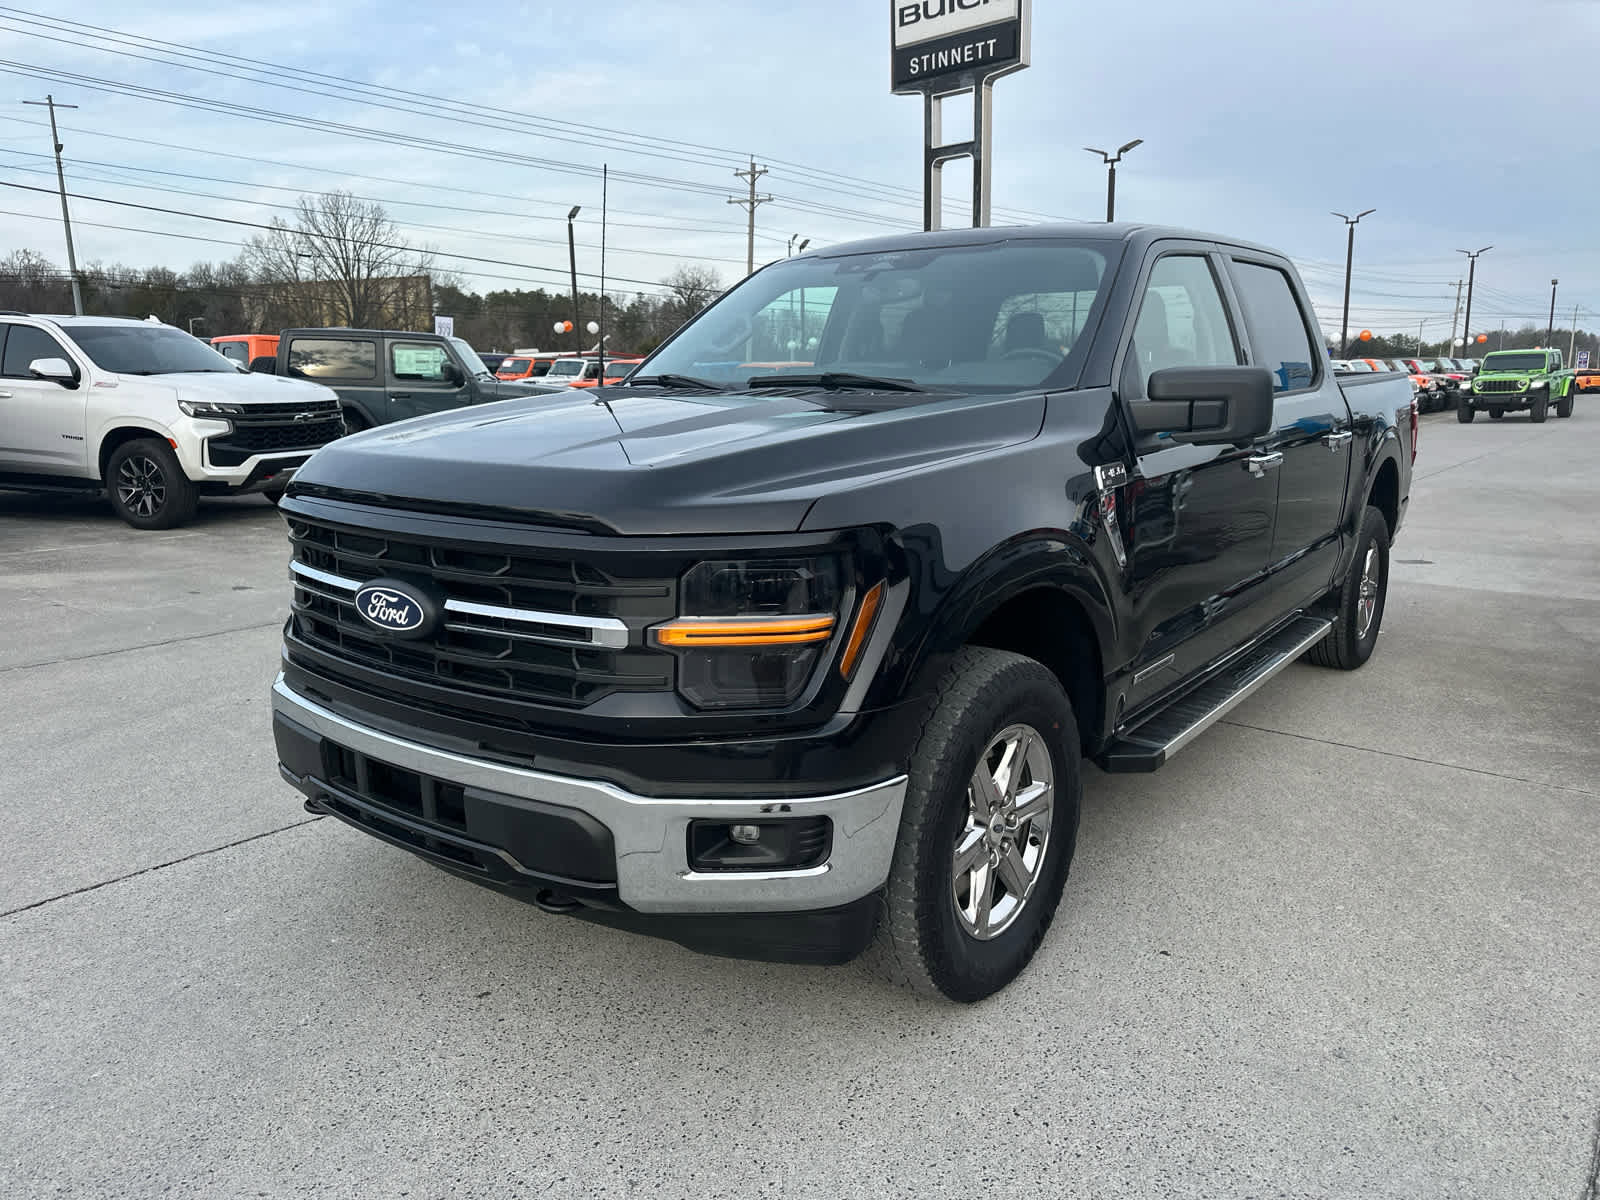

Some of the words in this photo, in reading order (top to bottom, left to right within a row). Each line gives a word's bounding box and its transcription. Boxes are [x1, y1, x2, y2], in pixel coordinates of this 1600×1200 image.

[898, 0, 990, 27] BUIC
[909, 38, 998, 75] STINNETT
[367, 591, 410, 625] Ford
